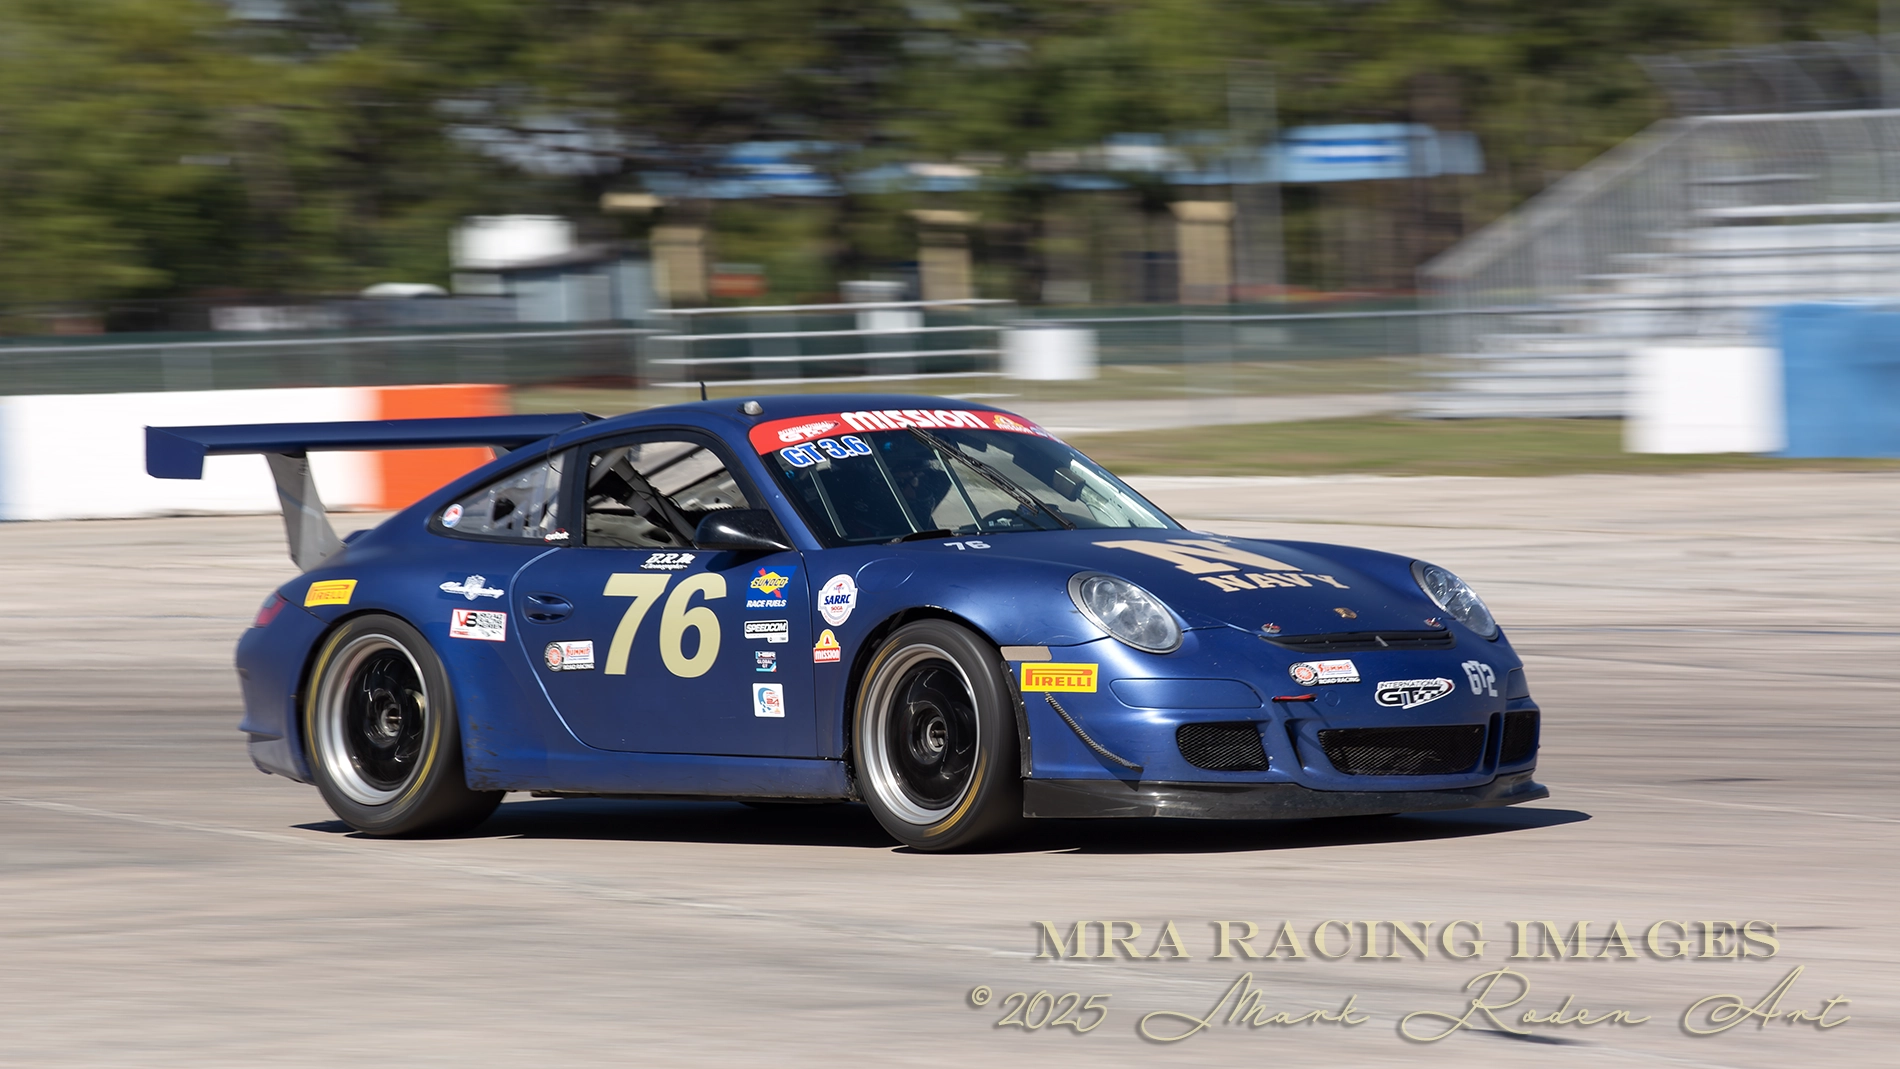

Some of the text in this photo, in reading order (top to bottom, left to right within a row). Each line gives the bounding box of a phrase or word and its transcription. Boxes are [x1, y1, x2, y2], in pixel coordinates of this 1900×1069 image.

[841, 410, 990, 431] MISSION
[780, 435, 873, 468] GT 3.6
[943, 540, 991, 551] 76
[752, 578, 787, 587] SUNOCO
[1197, 572, 1351, 593] NAVY
[307, 584, 350, 601] PIRELLI
[823, 593, 852, 605] SARRC
[746, 599, 787, 608] RACE FUELS
[602, 571, 728, 678] 76
[814, 649, 840, 660] MISSION
[1025, 668, 1093, 687] PIRELLI
[1378, 678, 1443, 690] INTERNATIONAL
